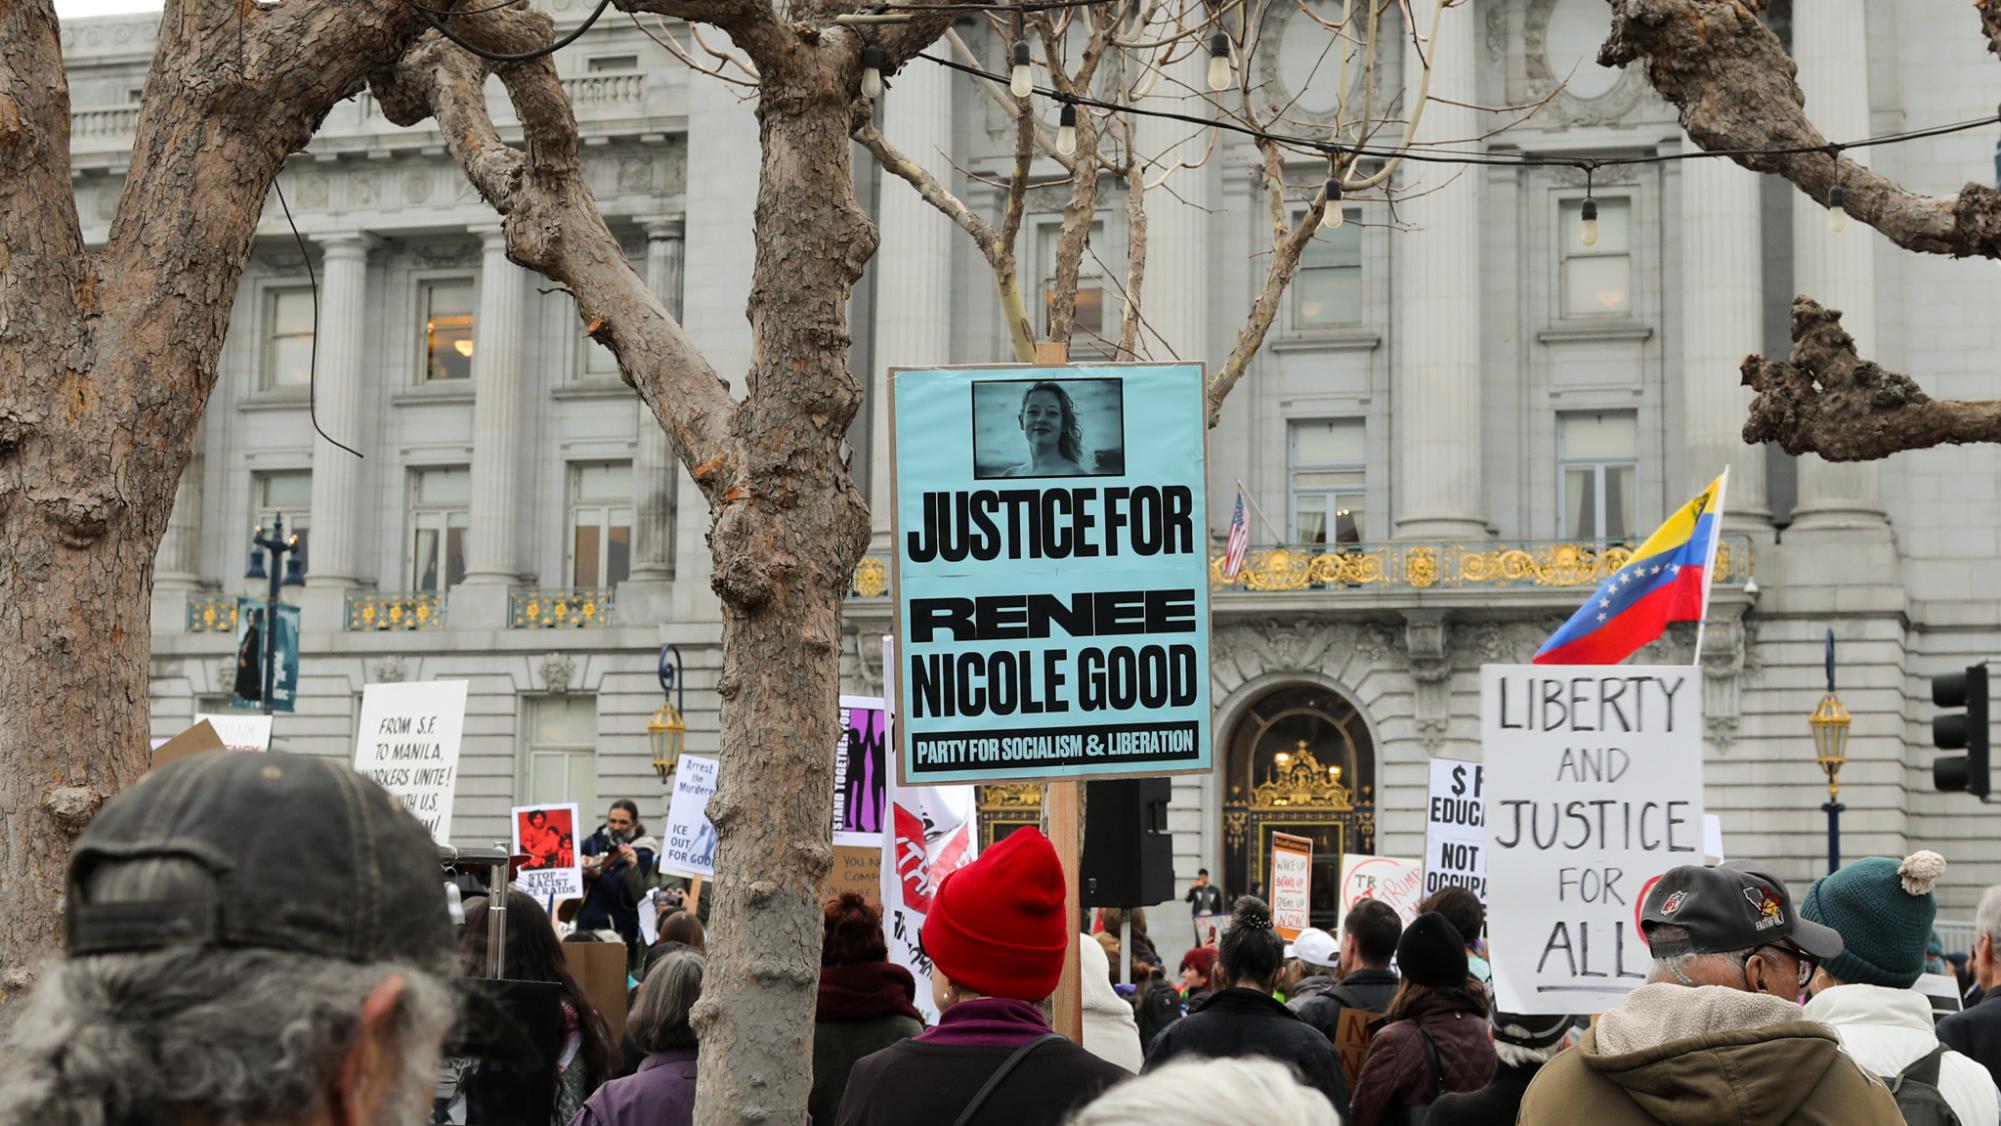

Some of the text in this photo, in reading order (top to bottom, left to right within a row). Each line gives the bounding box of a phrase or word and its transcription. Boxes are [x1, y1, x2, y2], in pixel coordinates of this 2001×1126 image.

[907, 485, 1194, 563] JUSTICE FOR
[909, 588, 1196, 643] RENEE
[911, 643, 1197, 718] NICOLE GOOD
[1499, 676, 1685, 733] LIBERTY
[378, 715, 437, 735] FROM S.F.
[376, 742, 444, 762] TO MANILA,
[917, 729, 1193, 764] PARTY FOR SOCIALISM & LIBERATION
[413, 766, 452, 788] UNITE!
[686, 759, 713, 775] Arrest
[833, 793, 845, 831] STAND
[839, 708, 851, 731] FOR
[1556, 747, 1630, 783] AND
[420, 793, 438, 812] U.S.
[673, 824, 688, 836] ICE
[1495, 800, 1696, 852] JUSTICE
[668, 849, 687, 862] FOR
[671, 837, 690, 849] OUT
[1441, 843, 1479, 872] NOT
[528, 872, 556, 880] STOP
[843, 856, 864, 867] YOU
[528, 879, 568, 887] RACIST
[1379, 868, 1421, 907] TRUMP
[1559, 867, 1626, 906] FOR
[1536, 921, 1647, 978] ALL
